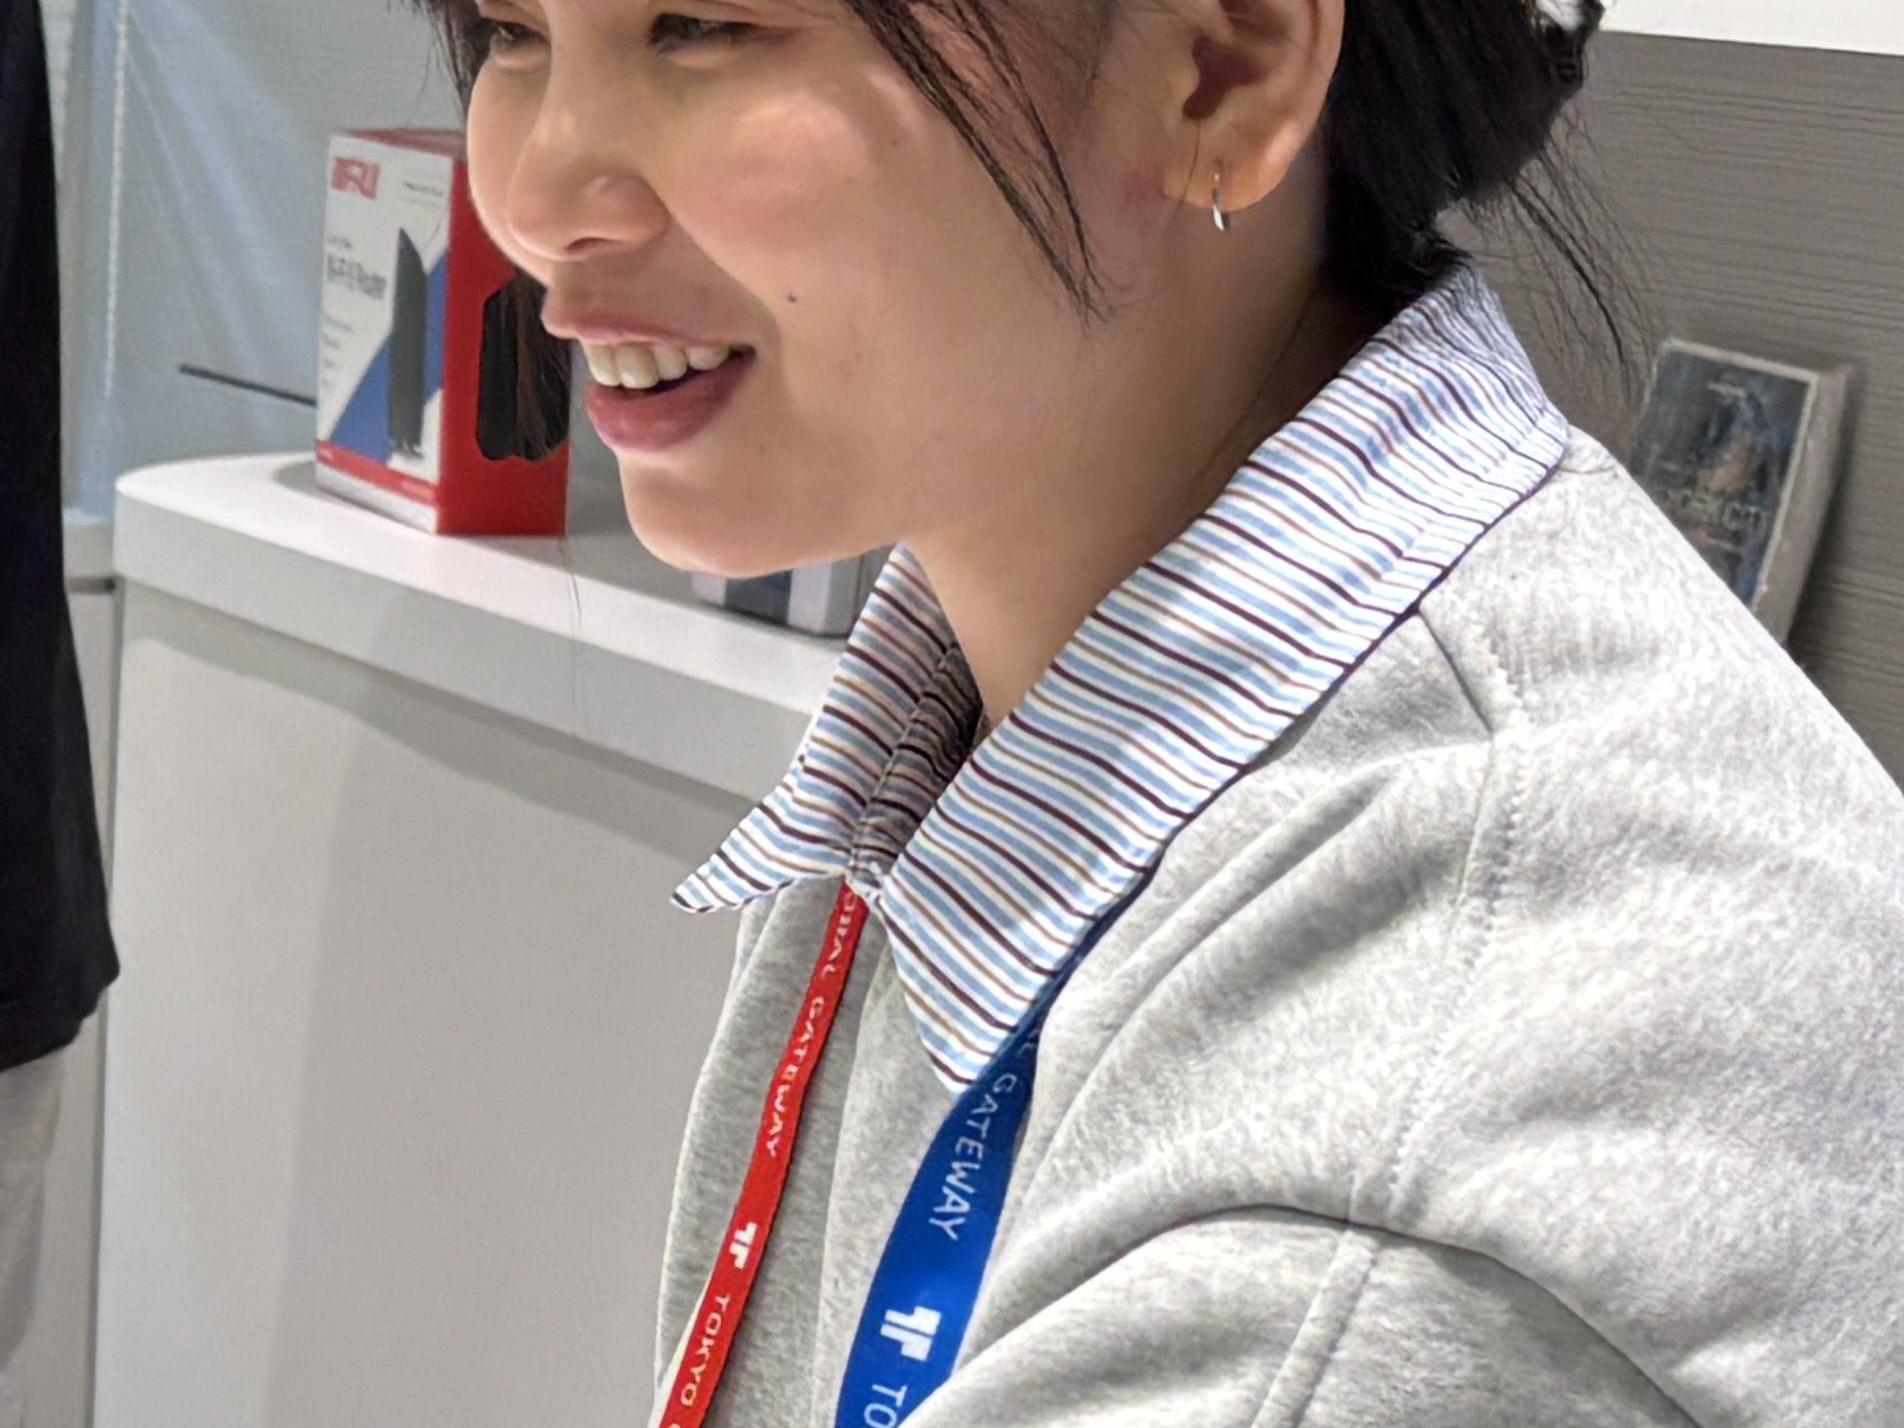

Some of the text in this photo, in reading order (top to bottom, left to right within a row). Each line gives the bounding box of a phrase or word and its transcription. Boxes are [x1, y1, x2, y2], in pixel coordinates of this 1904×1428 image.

[766, 890, 857, 1159] OBAL GATEWAY
[927, 1071, 1019, 1242] GATEWAY
[680, 1292, 732, 1408] TOKYO
